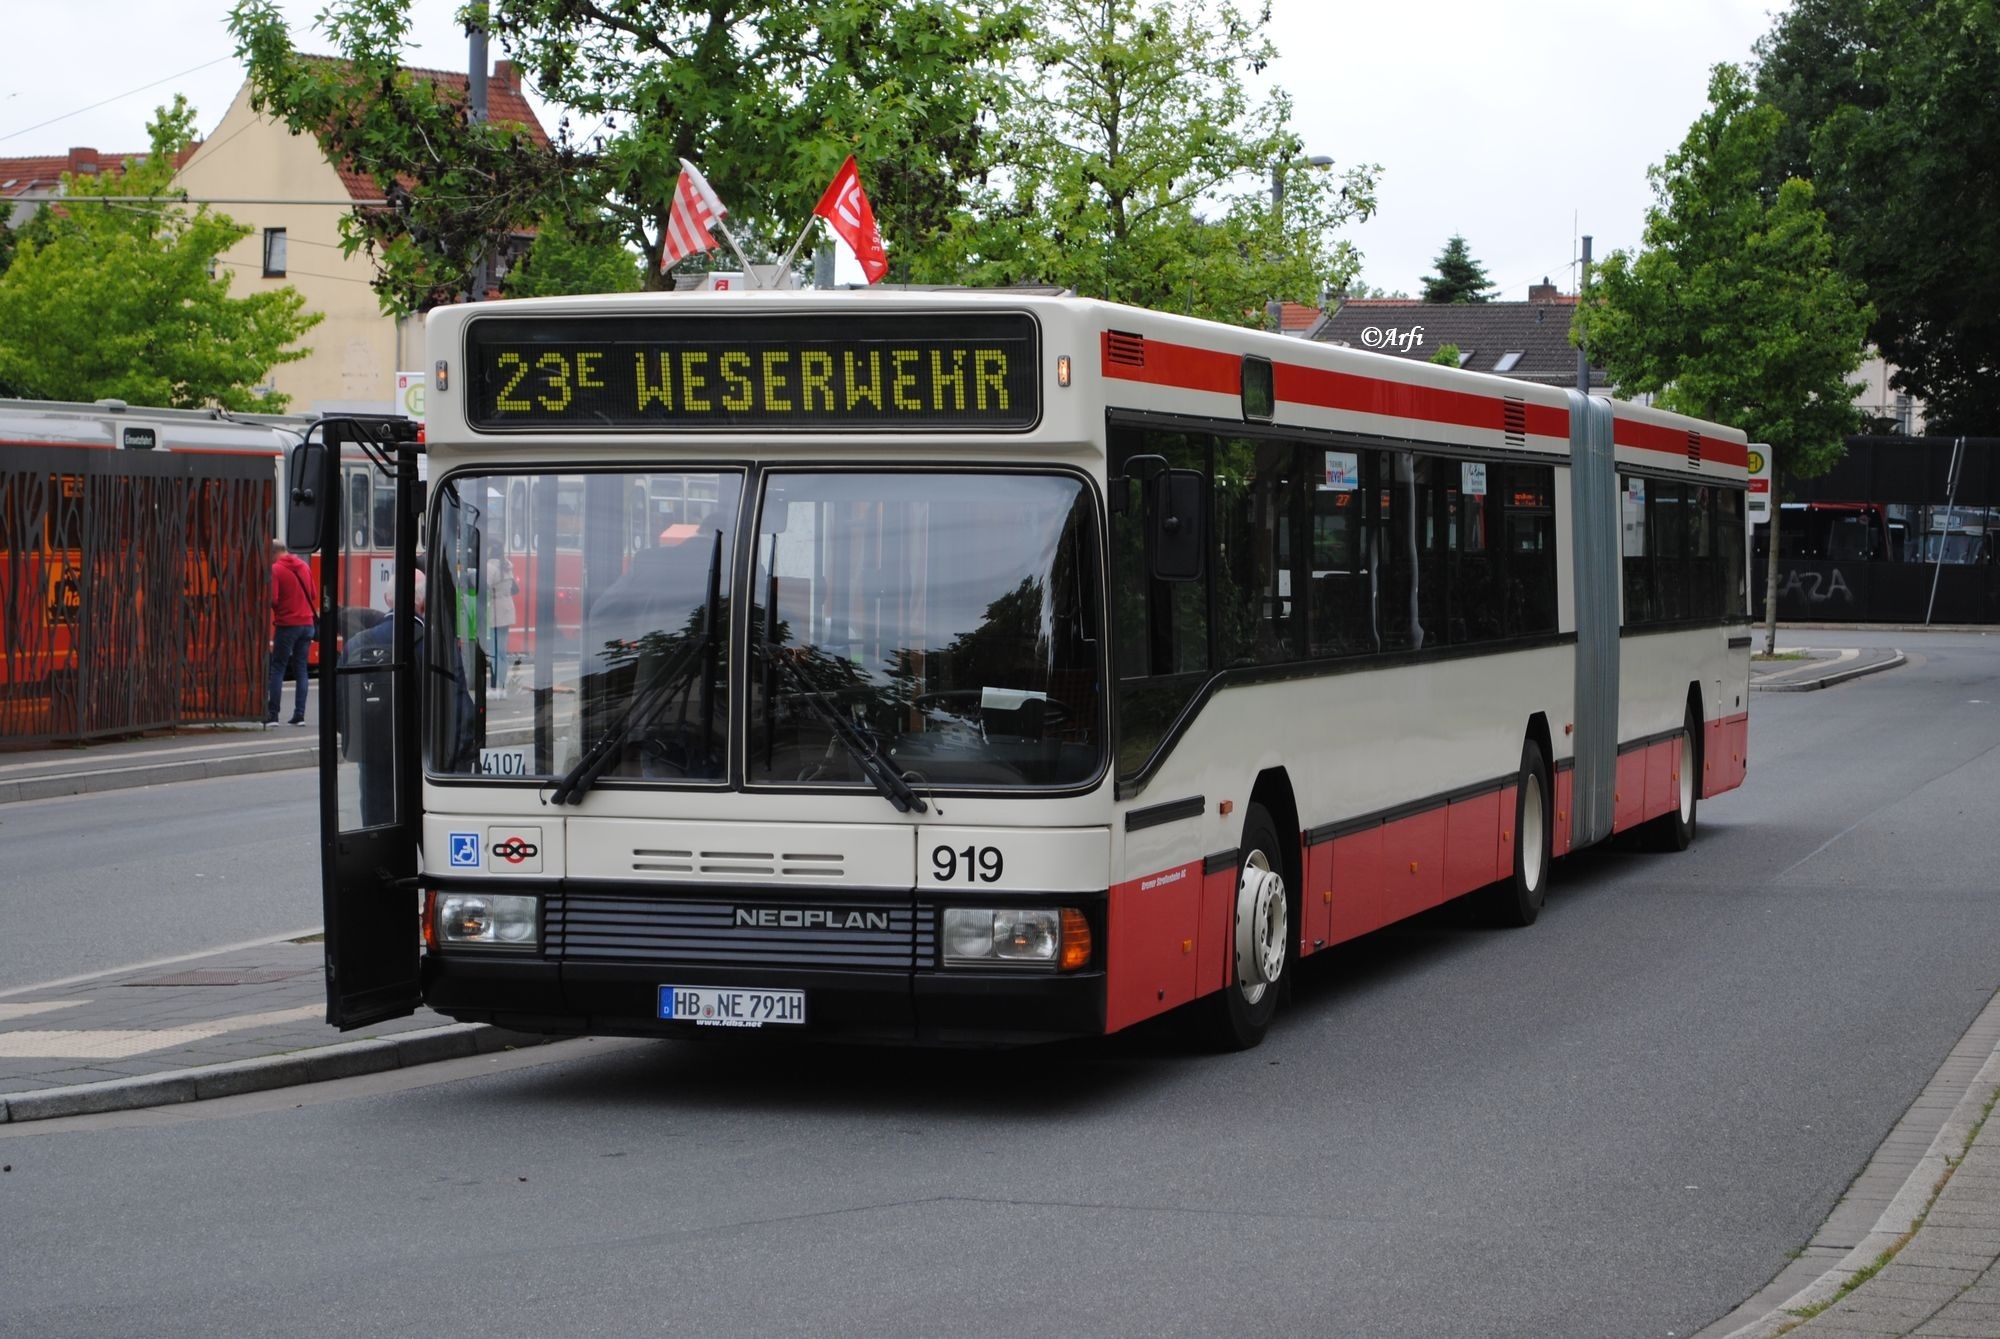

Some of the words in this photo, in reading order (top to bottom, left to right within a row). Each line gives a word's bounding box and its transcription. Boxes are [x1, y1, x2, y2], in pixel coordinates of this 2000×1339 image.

[497, 352, 605, 411] 23E
[635, 349, 1009, 411] WESERWEHR
[482, 753, 523, 775] 4107
[932, 845, 1004, 883] 919
[735, 908, 888, 930] NEOPLAN
[674, 992, 700, 1016] HB
[717, 993, 743, 1018] NE
[749, 994, 802, 1020] 791H
